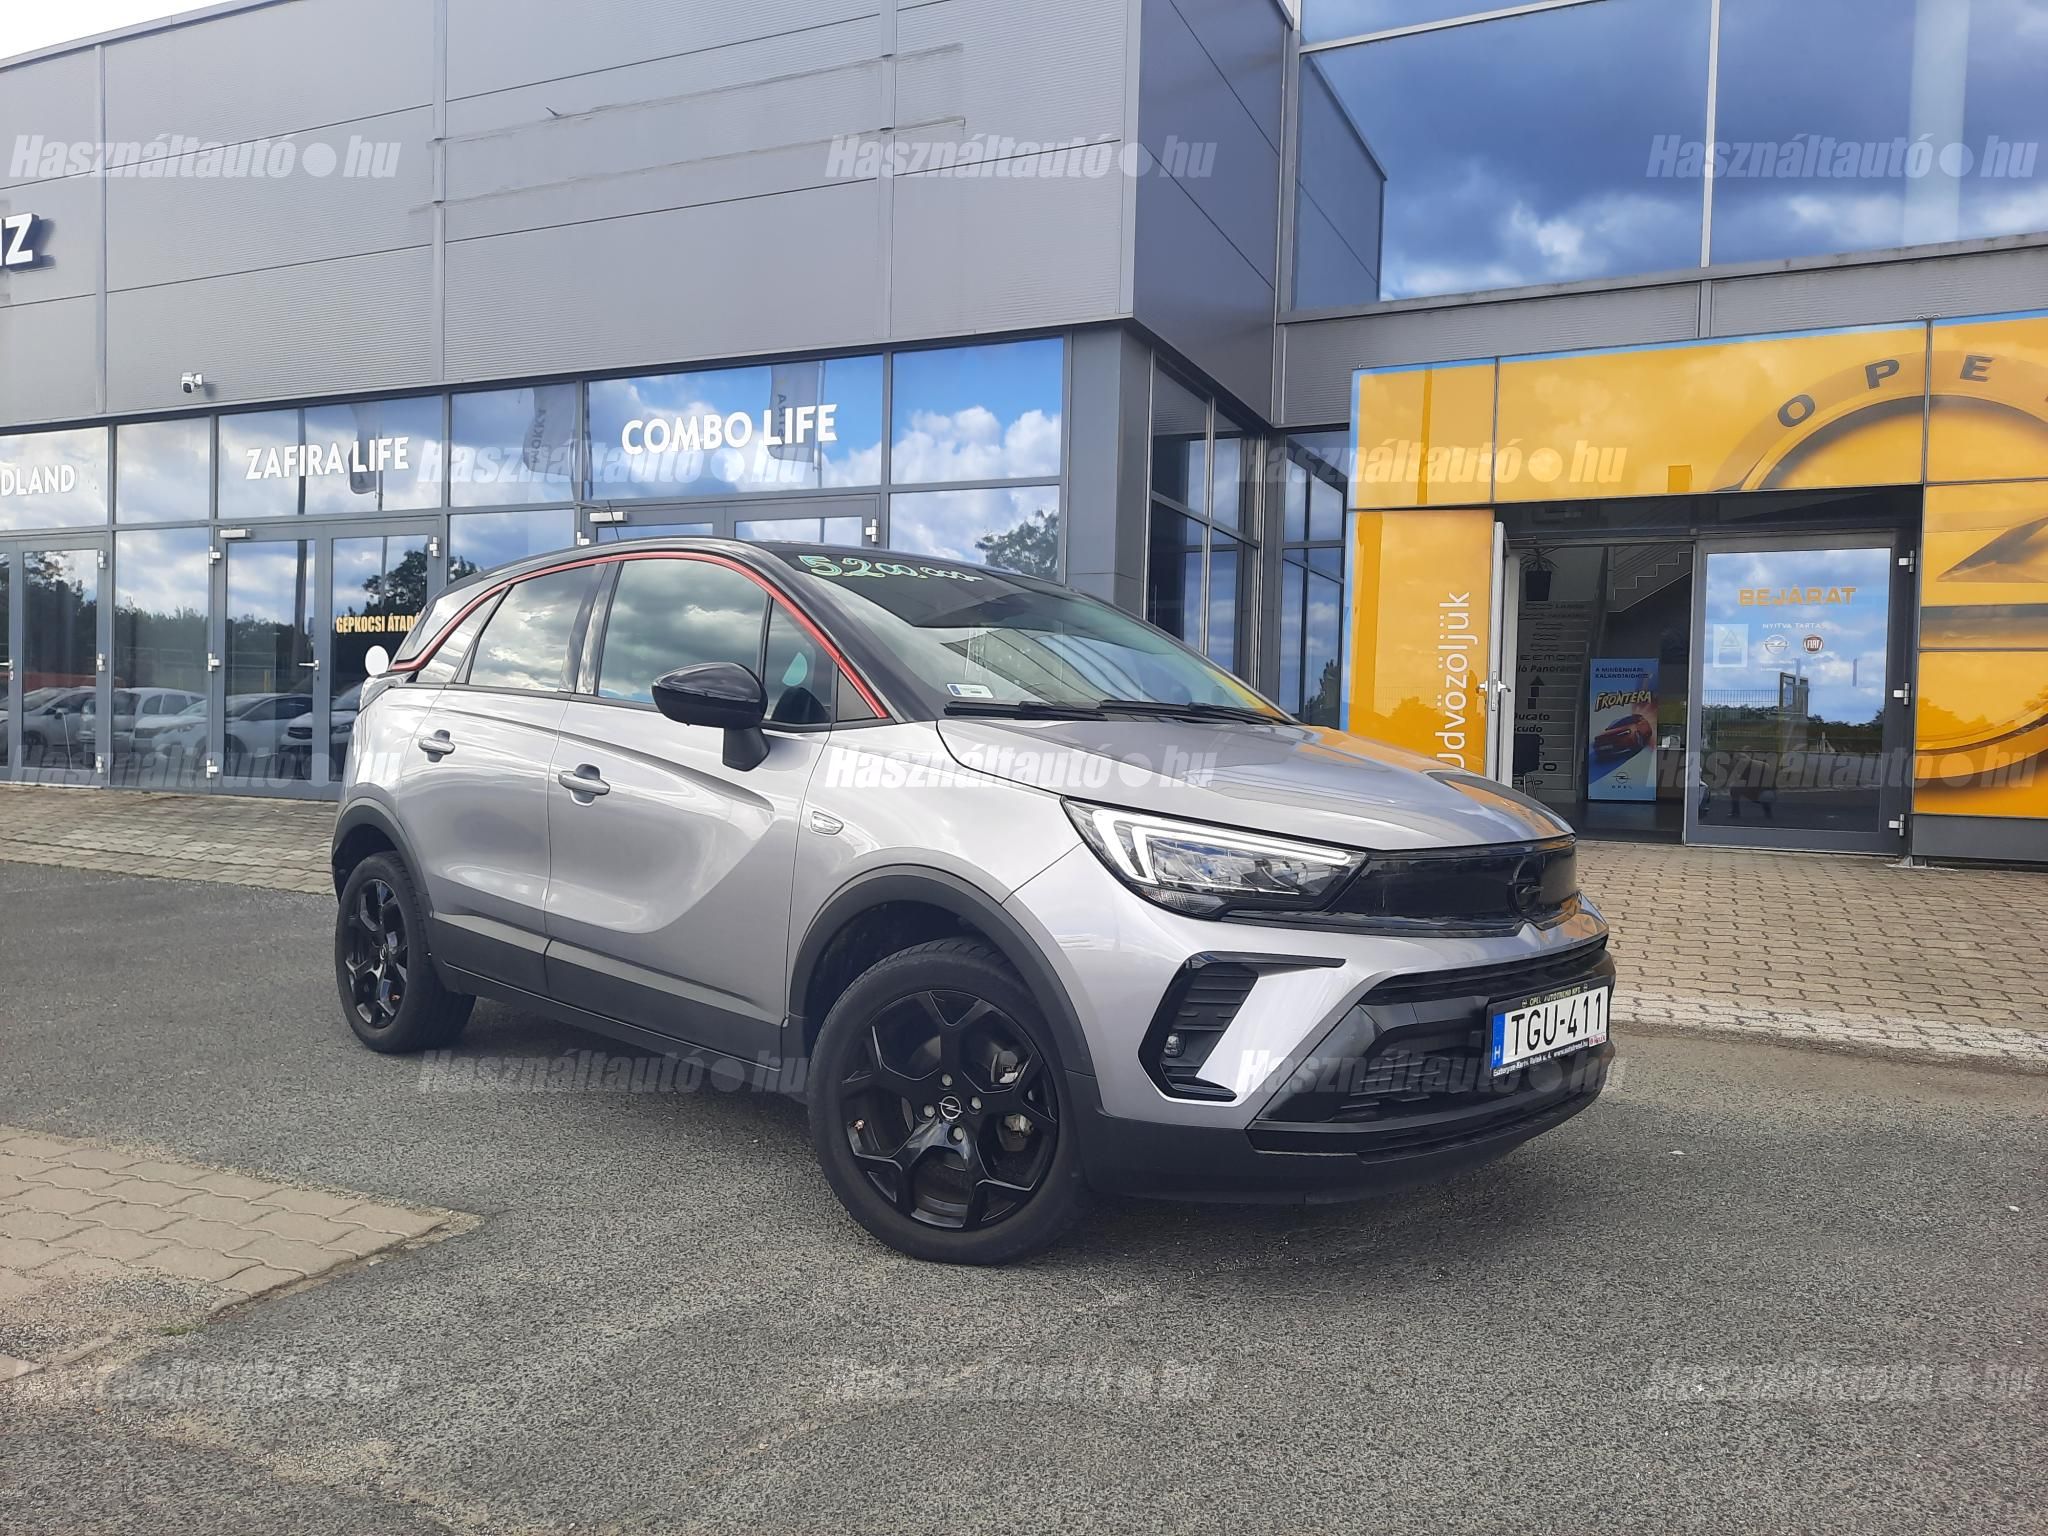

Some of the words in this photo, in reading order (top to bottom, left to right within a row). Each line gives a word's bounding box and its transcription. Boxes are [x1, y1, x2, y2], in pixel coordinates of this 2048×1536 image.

[0, 213, 33, 267] Z
[1777, 354, 2048, 428] OPE
[621, 411, 753, 455] COMBO
[763, 404, 838, 447] LIFE
[246, 442, 345, 480] ZAFIRA
[352, 437, 409, 472] LIFE
[1, 464, 76, 497] DLAND
[1738, 585, 1857, 606] BEJÁRAT
[335, 613, 386, 633] GÉPKOCSI
[1806, 639, 1821, 649] FIAT
[1594, 690, 1653, 712] FRONTERA
[1493, 1045, 1501, 1061] H
[1511, 992, 1602, 1056] TGU-411
